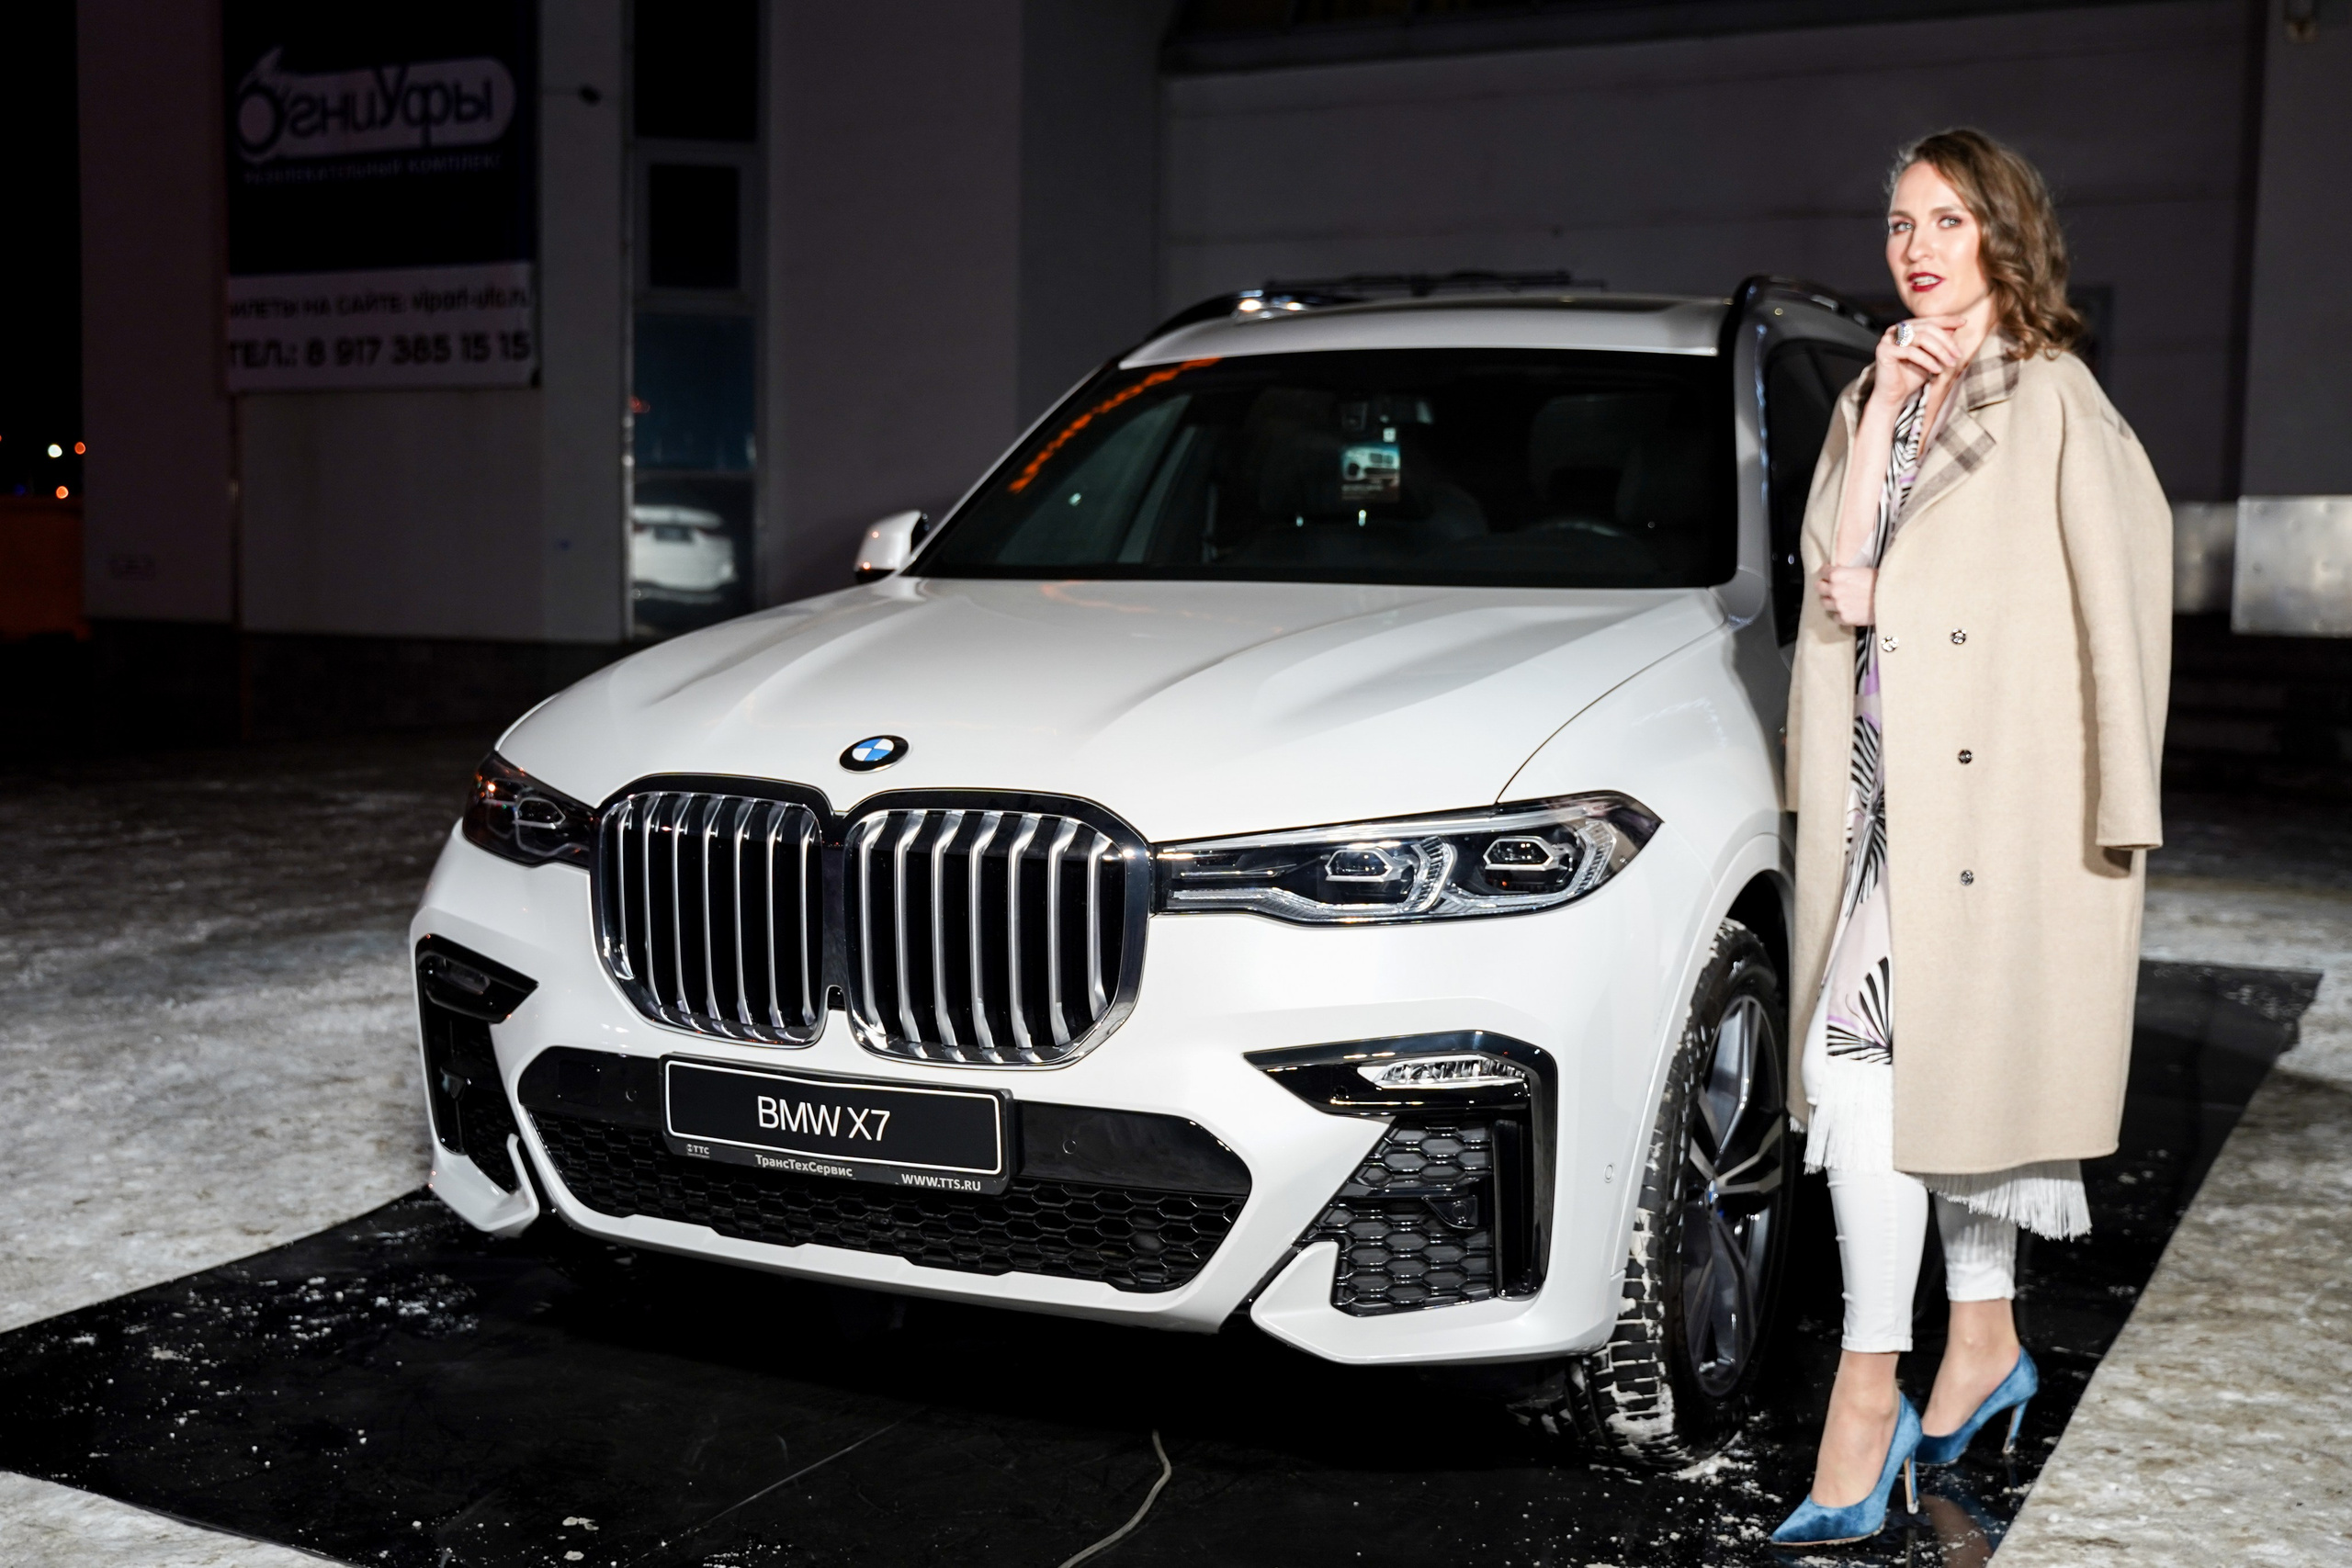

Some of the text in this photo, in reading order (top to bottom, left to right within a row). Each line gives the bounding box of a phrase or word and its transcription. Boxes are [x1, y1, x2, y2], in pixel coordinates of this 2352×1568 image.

[301, 295, 329, 317] НА
[305, 336, 324, 367] 8
[334, 333, 383, 367] 917
[460, 329, 491, 363] 15
[497, 326, 531, 361] 15
[757, 1095, 891, 1142] BMW X7
[754, 1154, 854, 1178] ТрансТехСервис
[900, 1173, 982, 1192] WWW.TTS.RU
